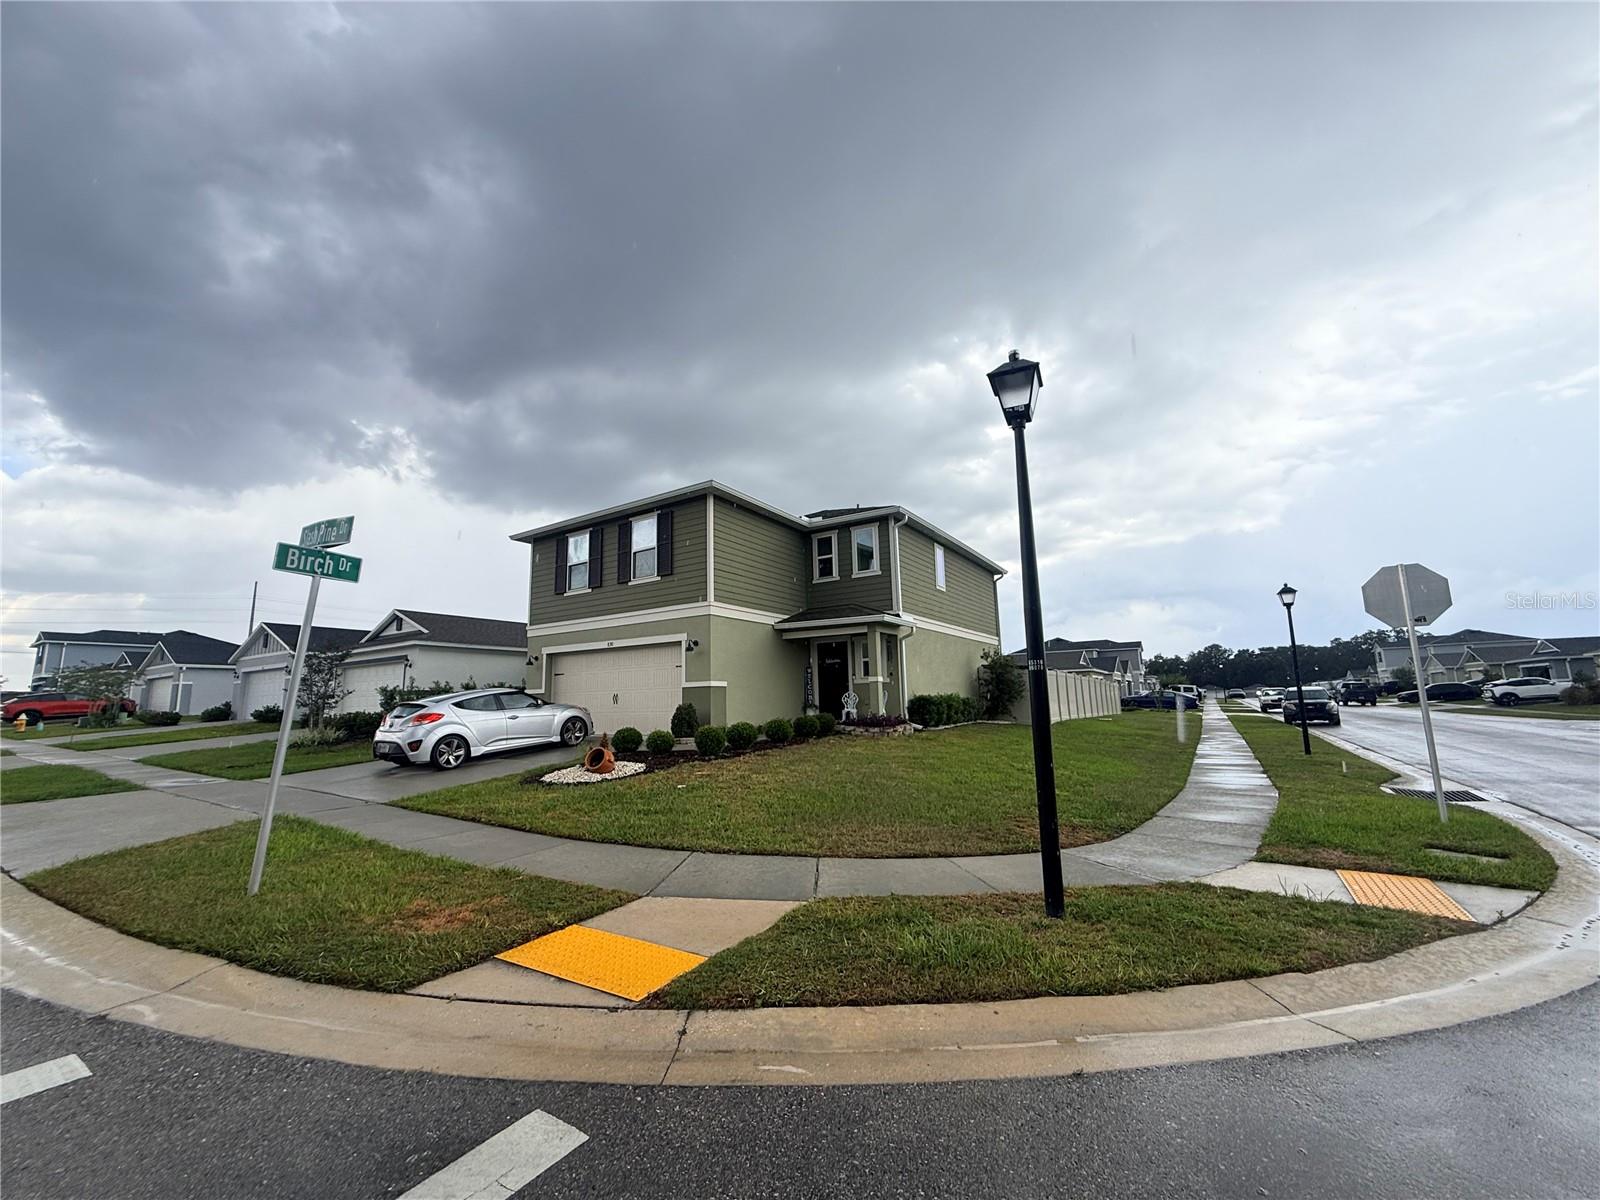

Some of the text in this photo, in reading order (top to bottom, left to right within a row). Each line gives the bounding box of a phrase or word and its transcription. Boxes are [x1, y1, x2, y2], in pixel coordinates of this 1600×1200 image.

[317, 523, 337, 543] Pine
[339, 520, 348, 535] Dr
[286, 548, 353, 575] Birch Dr
